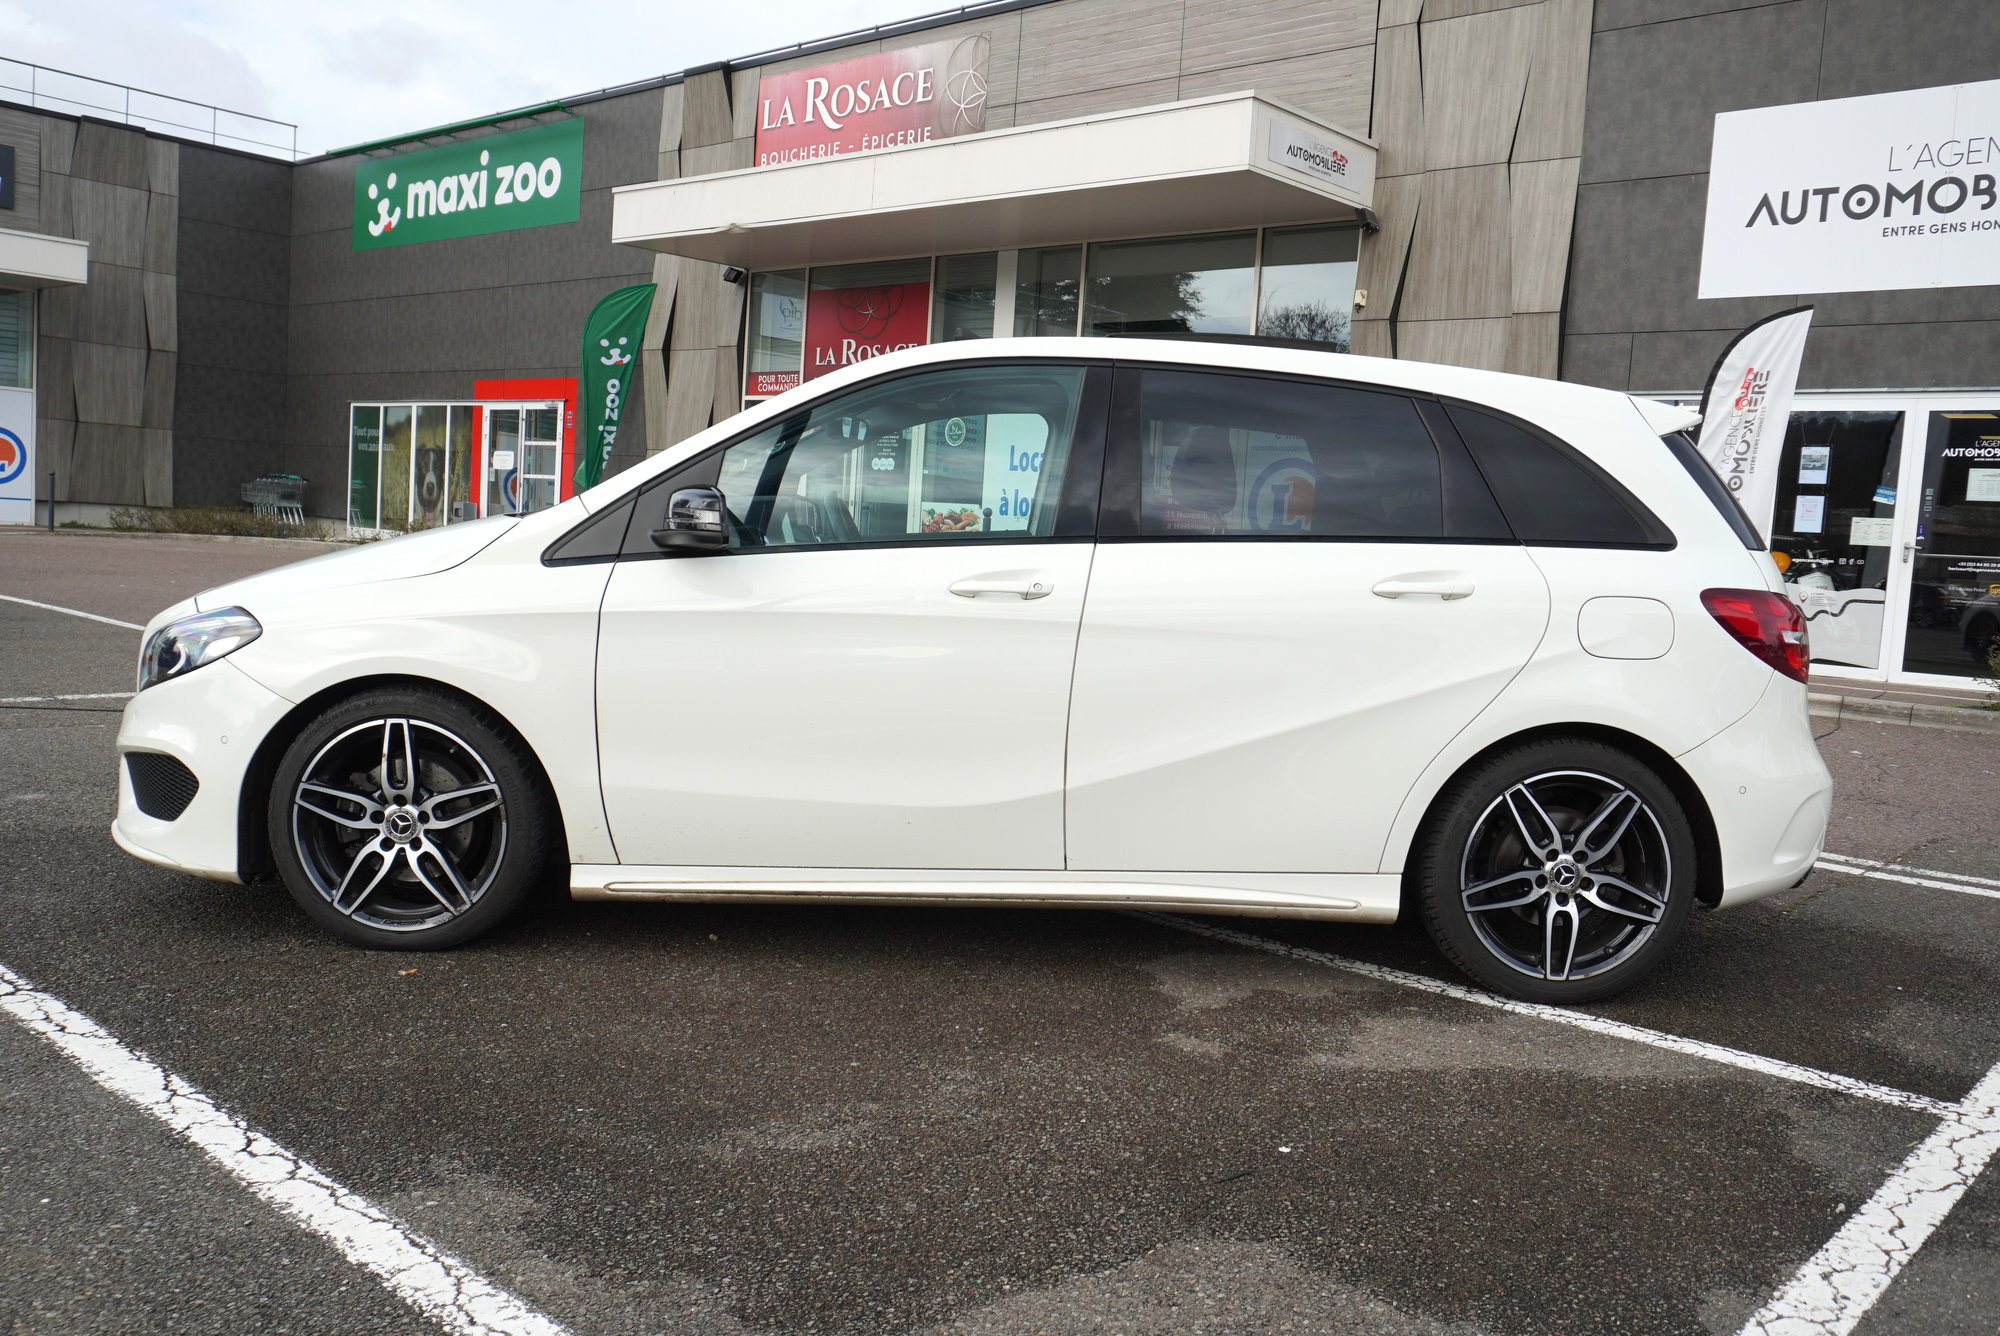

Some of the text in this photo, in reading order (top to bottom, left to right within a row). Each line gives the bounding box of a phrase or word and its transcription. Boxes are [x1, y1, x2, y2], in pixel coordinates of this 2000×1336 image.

[762, 67, 935, 131] LA ROSACE
[761, 142, 841, 167] BOUCHERIE
[862, 126, 932, 153] ÉPICERIE
[407, 149, 562, 219] maxi zoo
[1882, 223, 1925, 238] ENTRE
[1929, 220, 1968, 235] GENS
[816, 347, 837, 366] LA
[758, 373, 799, 384] POUR TOUTE
[605, 378, 621, 421] zoo
[353, 426, 380, 441] Tout pou
[1749, 456, 1757, 475] ENTRE
[999, 489, 1034, 517] à lo
